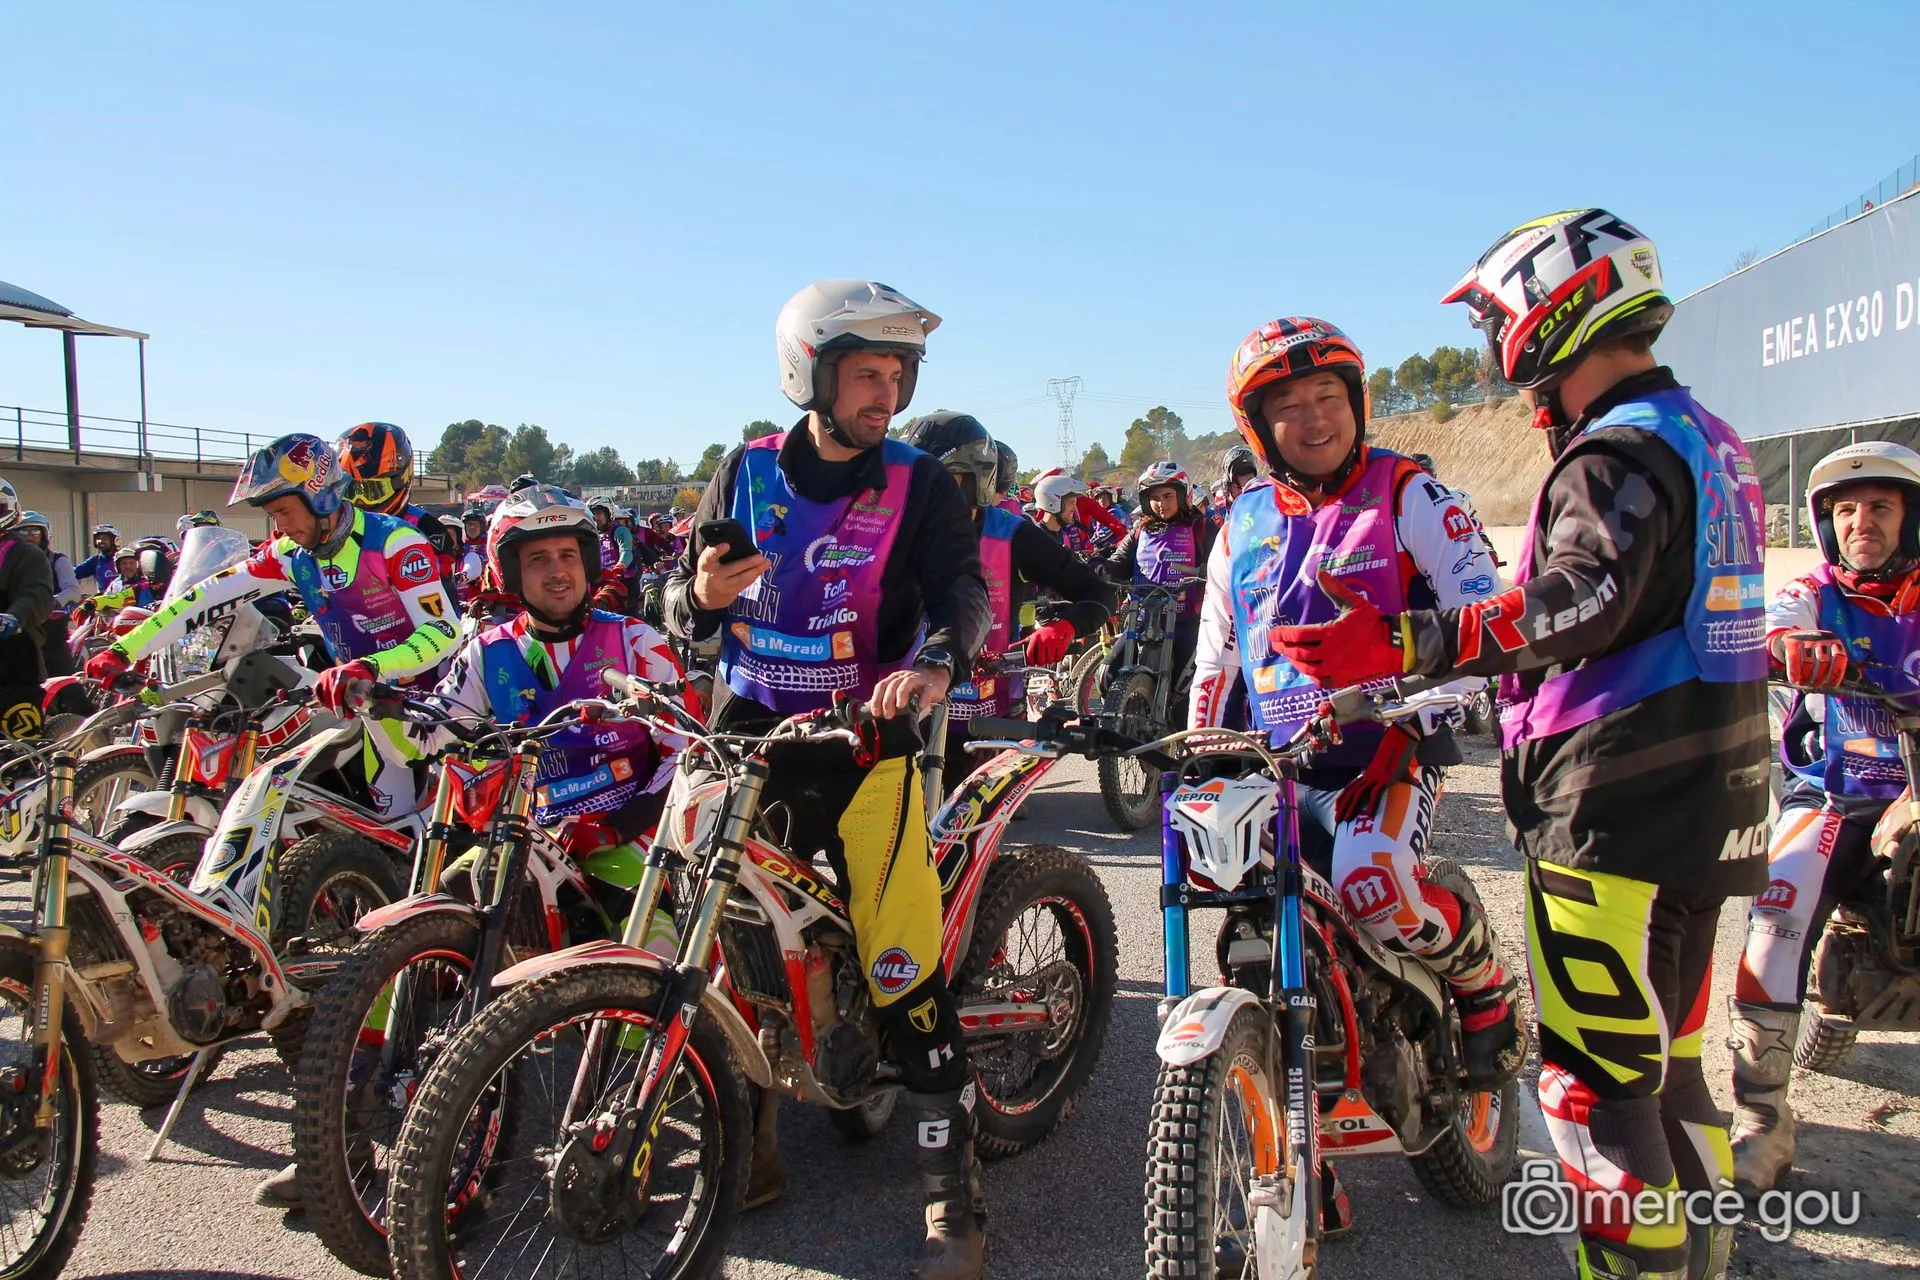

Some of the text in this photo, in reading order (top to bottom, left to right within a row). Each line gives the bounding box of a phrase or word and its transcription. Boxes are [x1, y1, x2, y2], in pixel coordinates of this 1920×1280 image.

[1763, 278, 1920, 367] EMEA EX30 D
[1278, 333, 1317, 347] SHOEI
[536, 514, 567, 524] TRS
[402, 558, 431, 576] NILS
[1533, 573, 1618, 640] team
[808, 607, 858, 630] TrialGo
[751, 633, 766, 649] La
[769, 637, 825, 656] Marató
[1195, 677, 1217, 728] NDA
[594, 730, 620, 746] fcm
[1003, 783, 1026, 806] hebo
[1174, 792, 1221, 803] REPSOL
[874, 782, 903, 902] ADVANCED TRIAL TECHNOLOGY
[1718, 821, 1768, 861] MO
[1816, 812, 1841, 859] HON
[872, 963, 919, 979] NILS
[39, 984, 50, 1030] hebo
[1164, 1040, 1207, 1051] REPSOL
